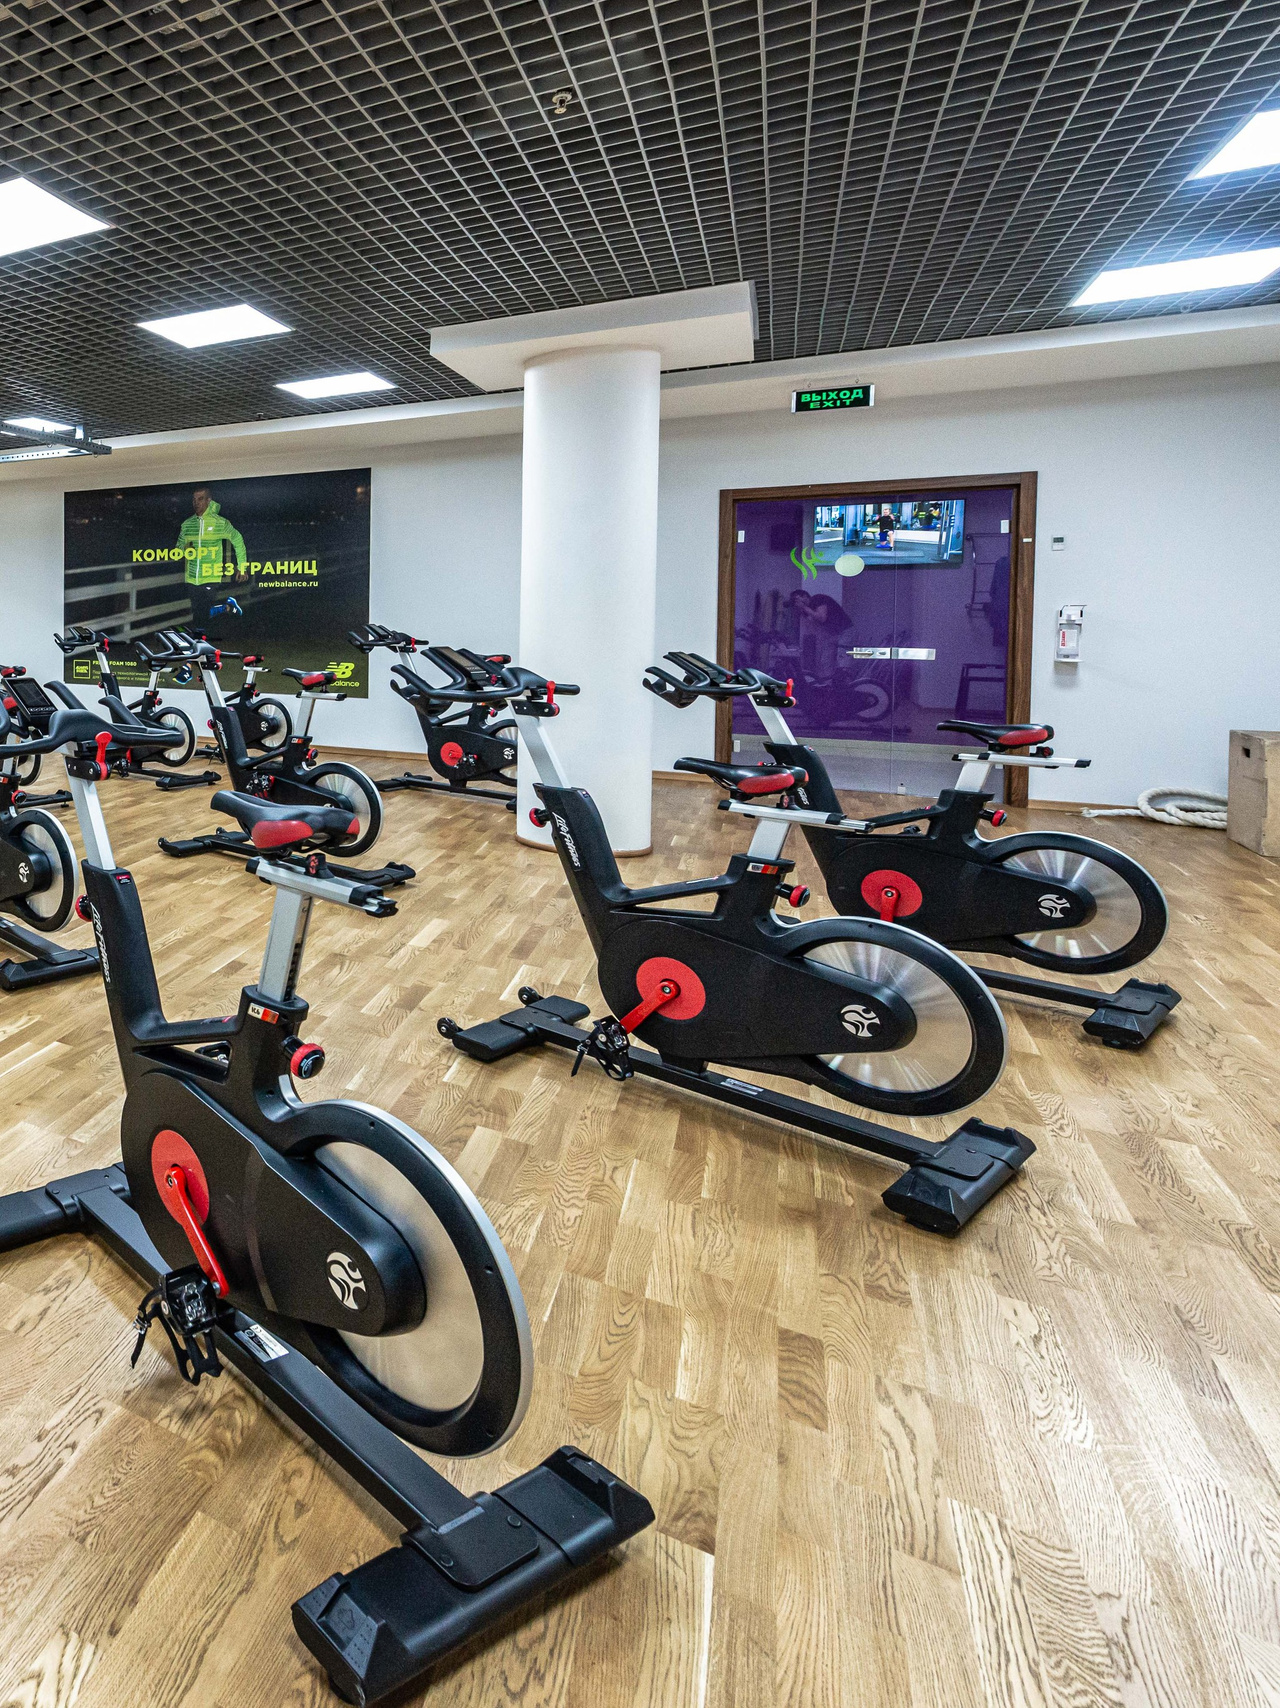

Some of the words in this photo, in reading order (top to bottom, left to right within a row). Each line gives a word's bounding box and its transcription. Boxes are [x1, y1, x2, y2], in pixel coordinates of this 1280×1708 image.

[801, 389, 864, 403] ВЫХОД
[809, 398, 854, 409] EXIT
[132, 546, 219, 562] КОМФОРТ
[201, 562, 235, 577] БЕЗ
[240, 560, 318, 576] ГРАНИЦ
[258, 580, 319, 588] newbalance.ru
